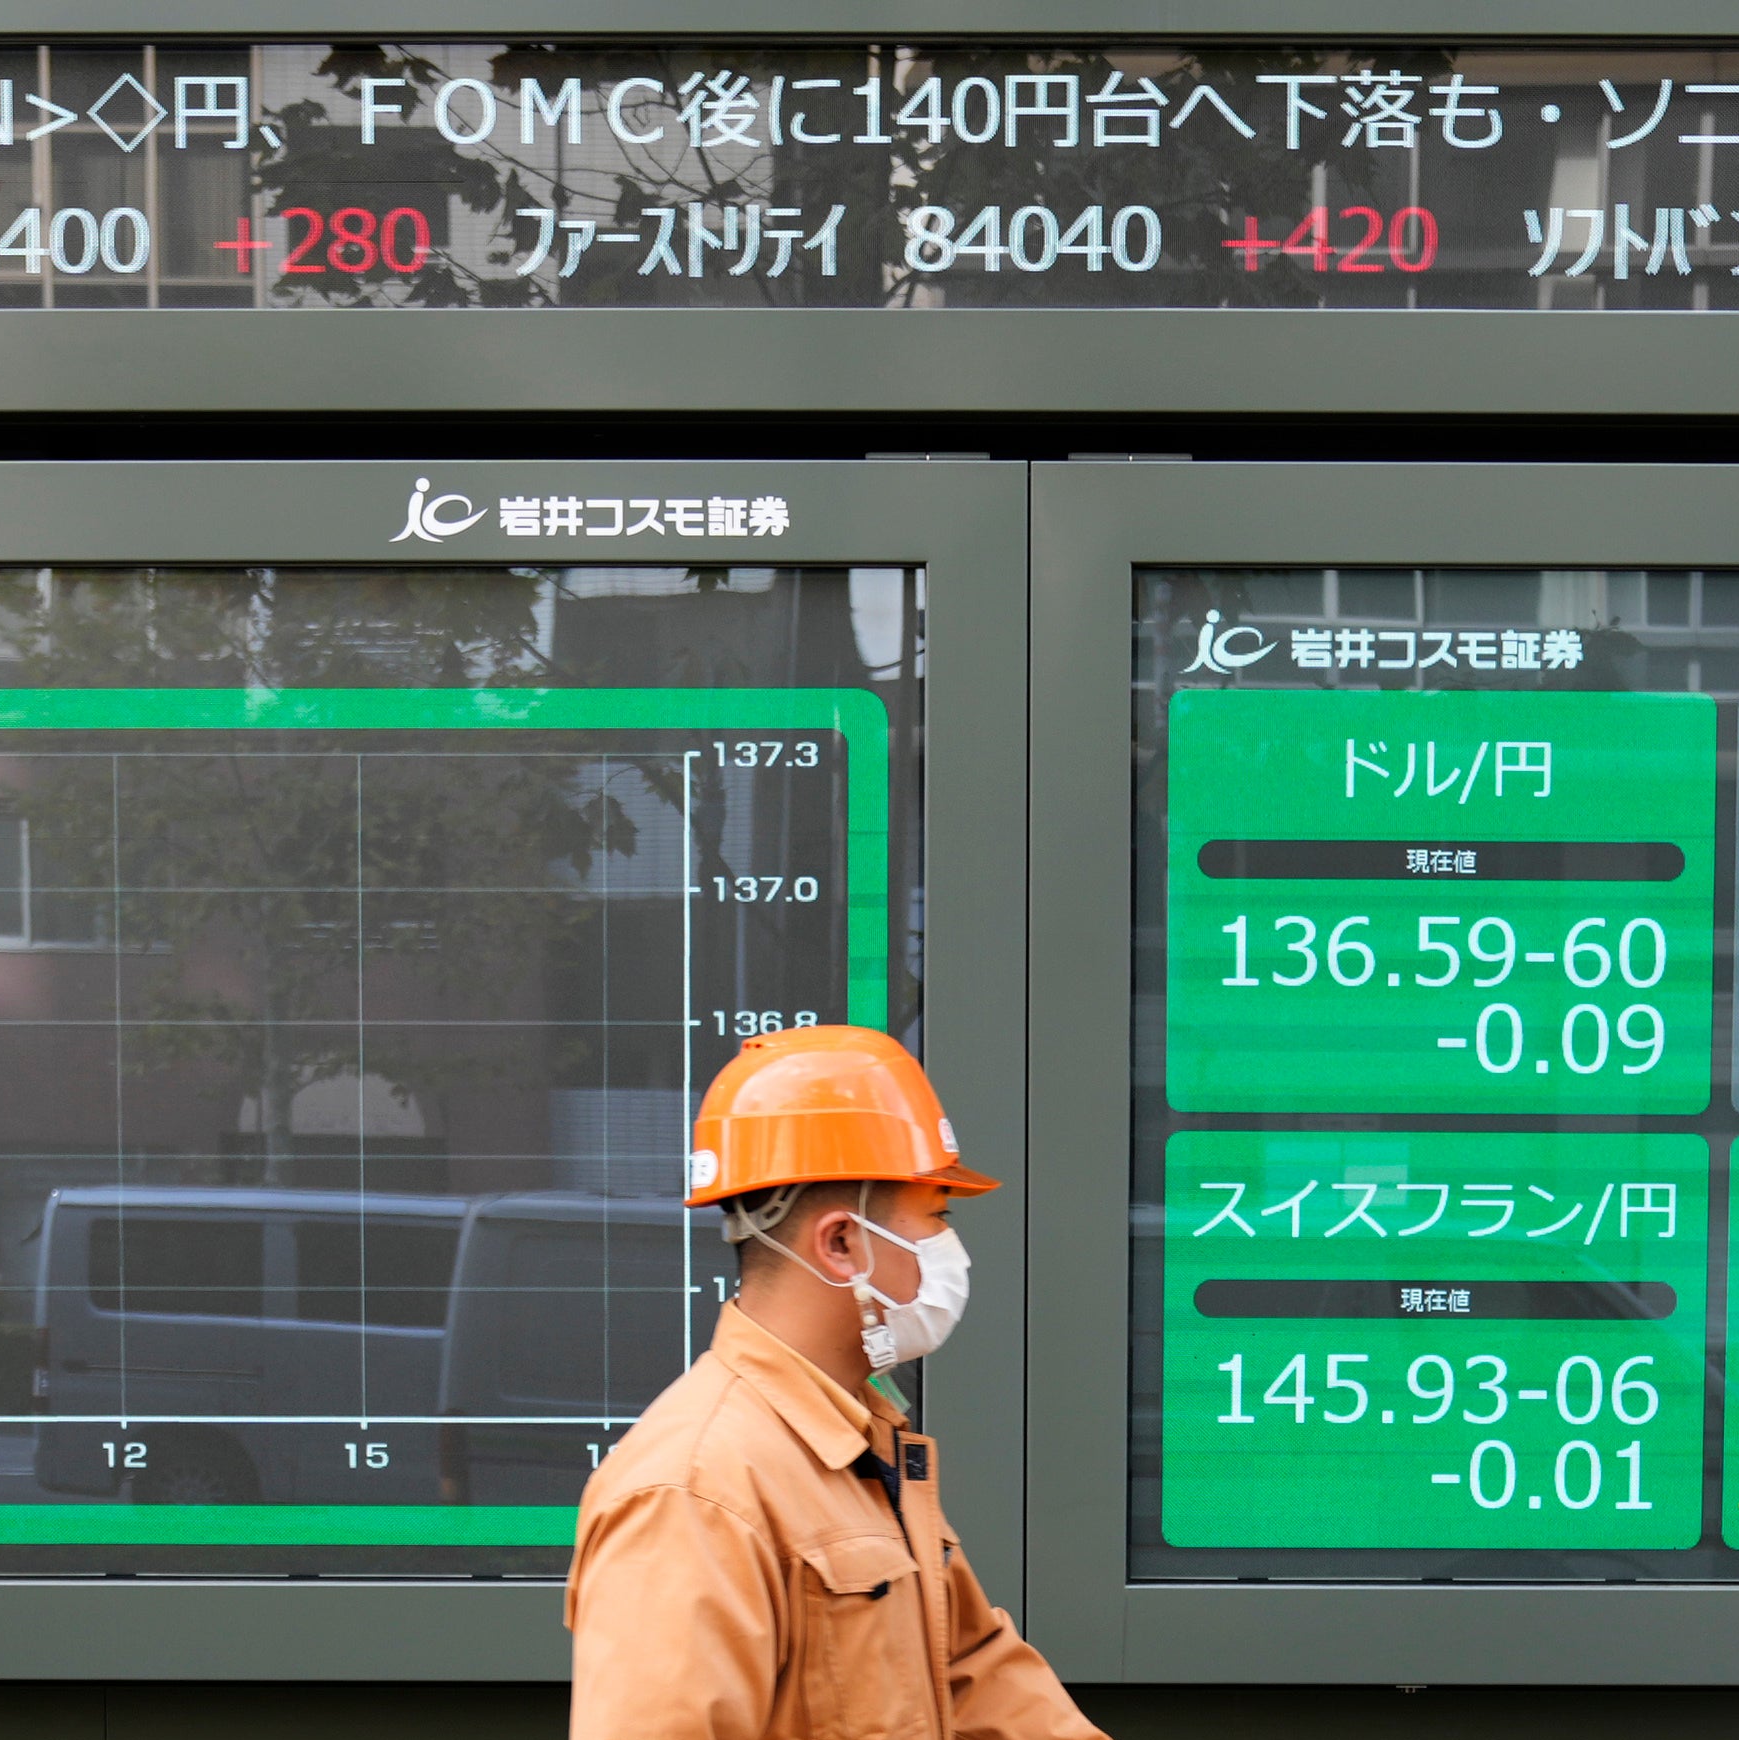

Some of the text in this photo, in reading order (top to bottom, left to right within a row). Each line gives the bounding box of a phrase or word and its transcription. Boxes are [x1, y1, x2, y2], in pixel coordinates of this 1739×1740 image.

[212, 206, 431, 274] +280
[902, 204, 1162, 275] 84040
[1220, 204, 1439, 275] +420
[499, 495, 791, 537] 岩井コスモ証券
[1290, 628, 1585, 670] 岩井コスモ証券
[712, 742, 820, 768] 137.3
[1345, 737, 1553, 805] ドル/円
[1406, 848, 1477, 875] 現在値
[712, 877, 820, 903] 137.0
[1221, 915, 1667, 988] 136.59-60
[1437, 1003, 1666, 1074] -0.09
[1192, 1179, 1677, 1245] スイスフラン/円
[1400, 1287, 1471, 1313] 現在値
[1216, 1353, 1660, 1426] 145.93-06
[102, 1442, 148, 1468] 12
[344, 1443, 390, 1469] 15
[585, 1442, 621, 1470] 1
[1431, 1439, 1653, 1510] -0.01
